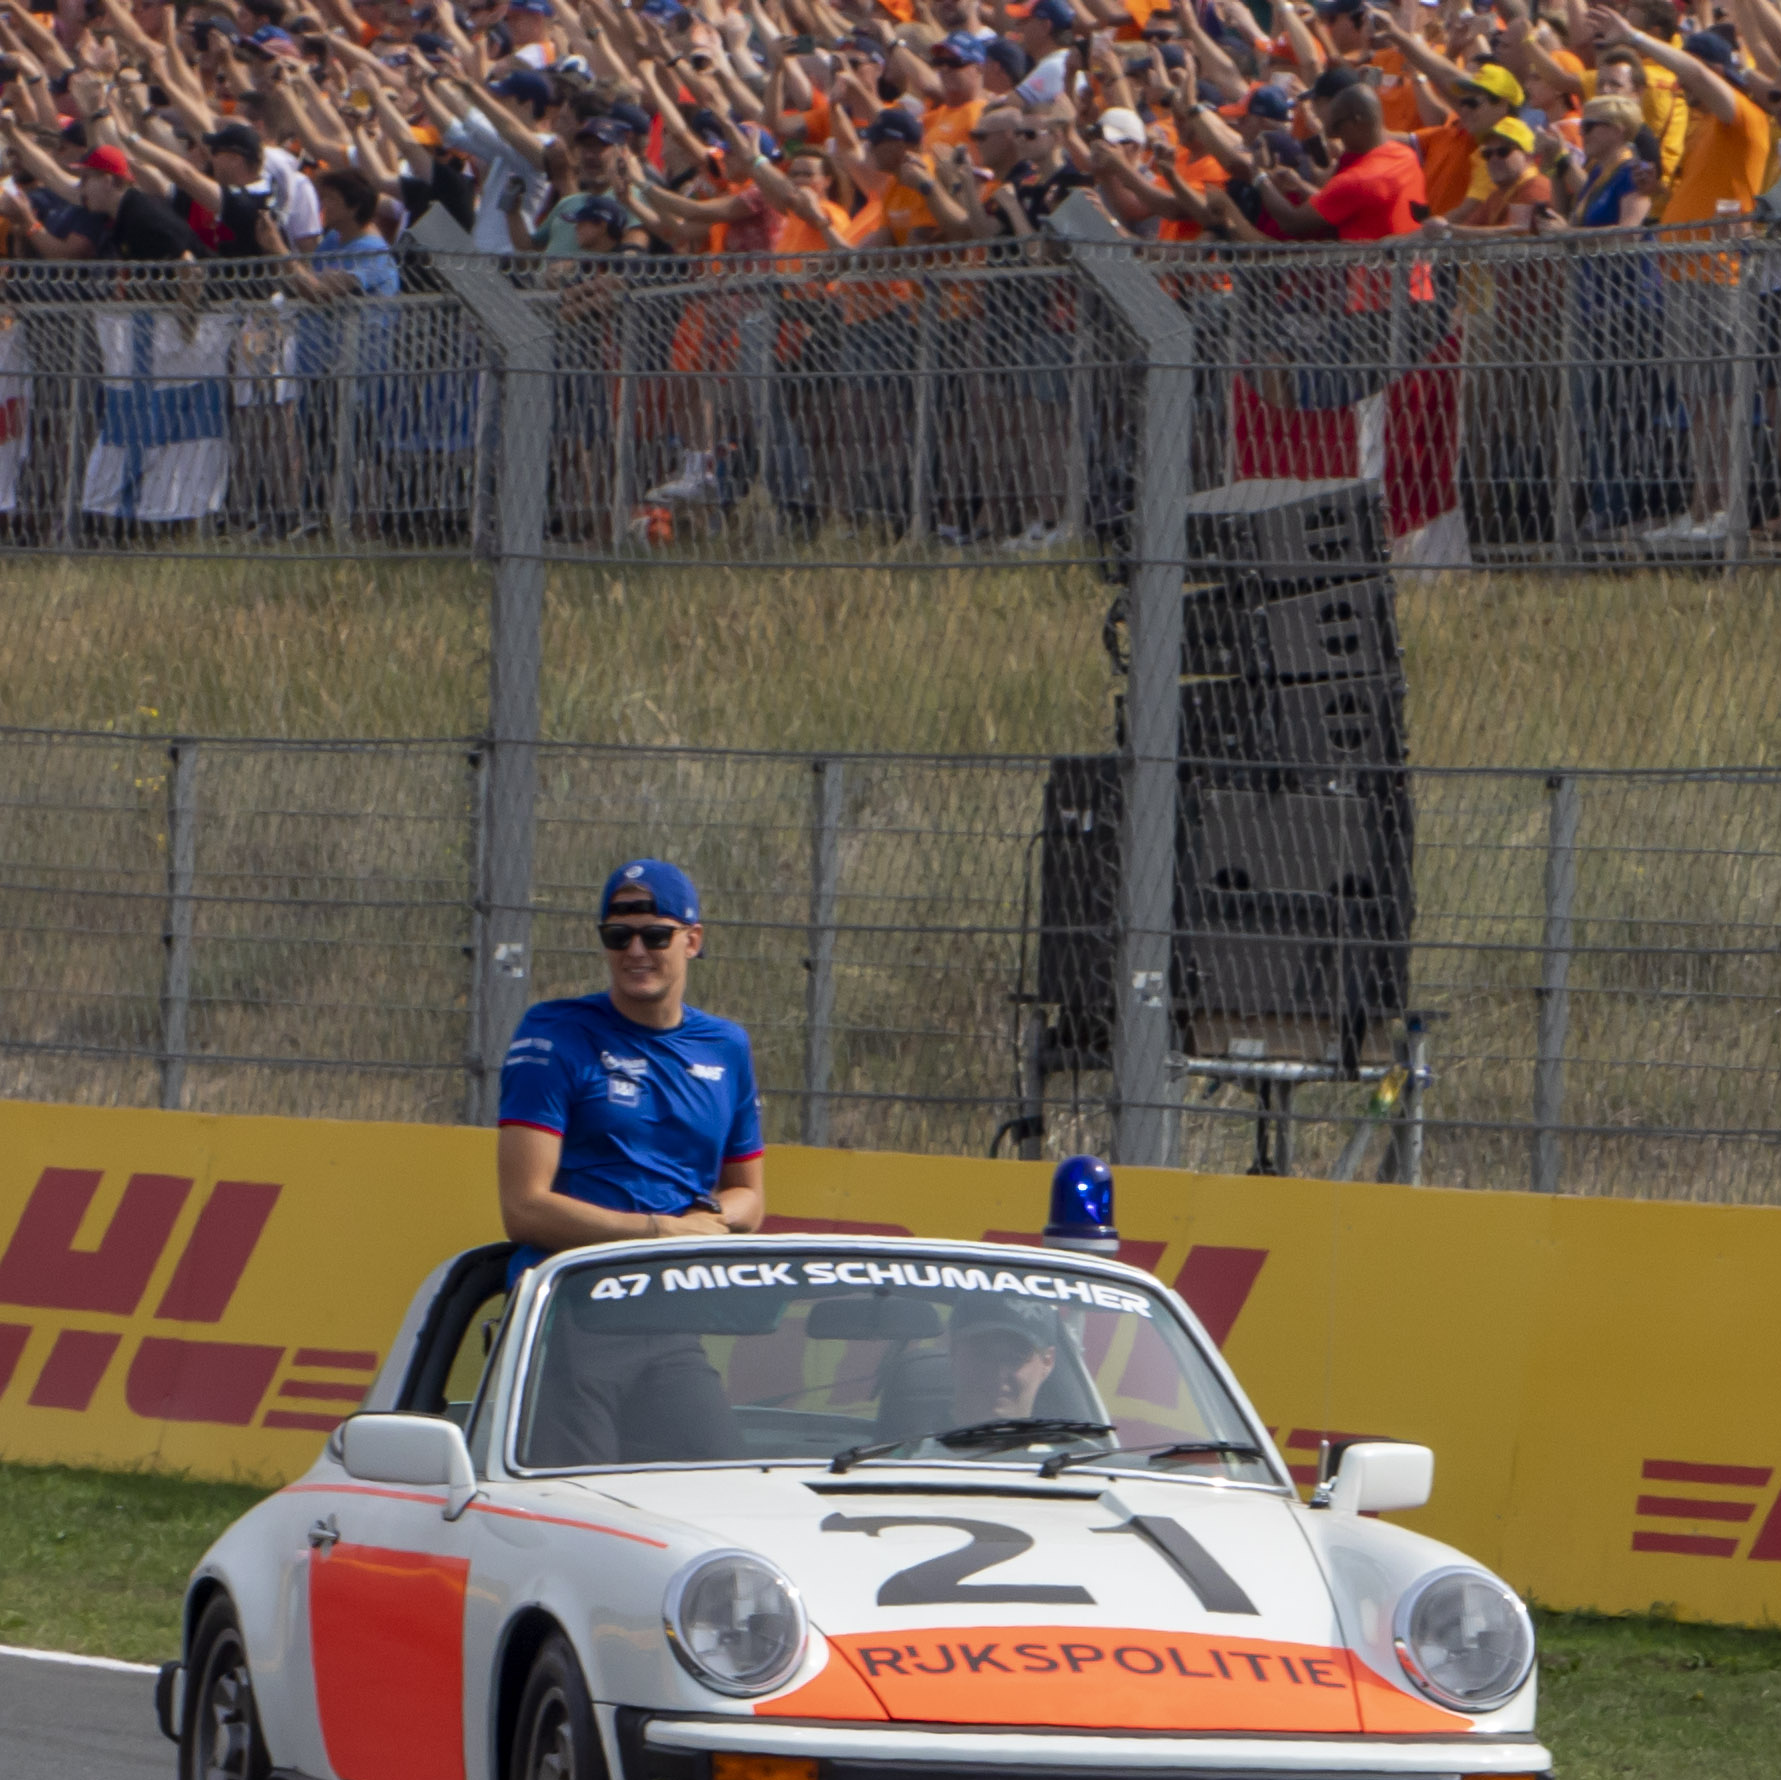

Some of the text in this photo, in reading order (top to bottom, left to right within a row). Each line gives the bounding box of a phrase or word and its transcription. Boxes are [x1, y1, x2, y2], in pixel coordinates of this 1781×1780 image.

[590, 1261, 1152, 1319] 47 MICK SCHUMACHER
[820, 1512, 1260, 1616] 21
